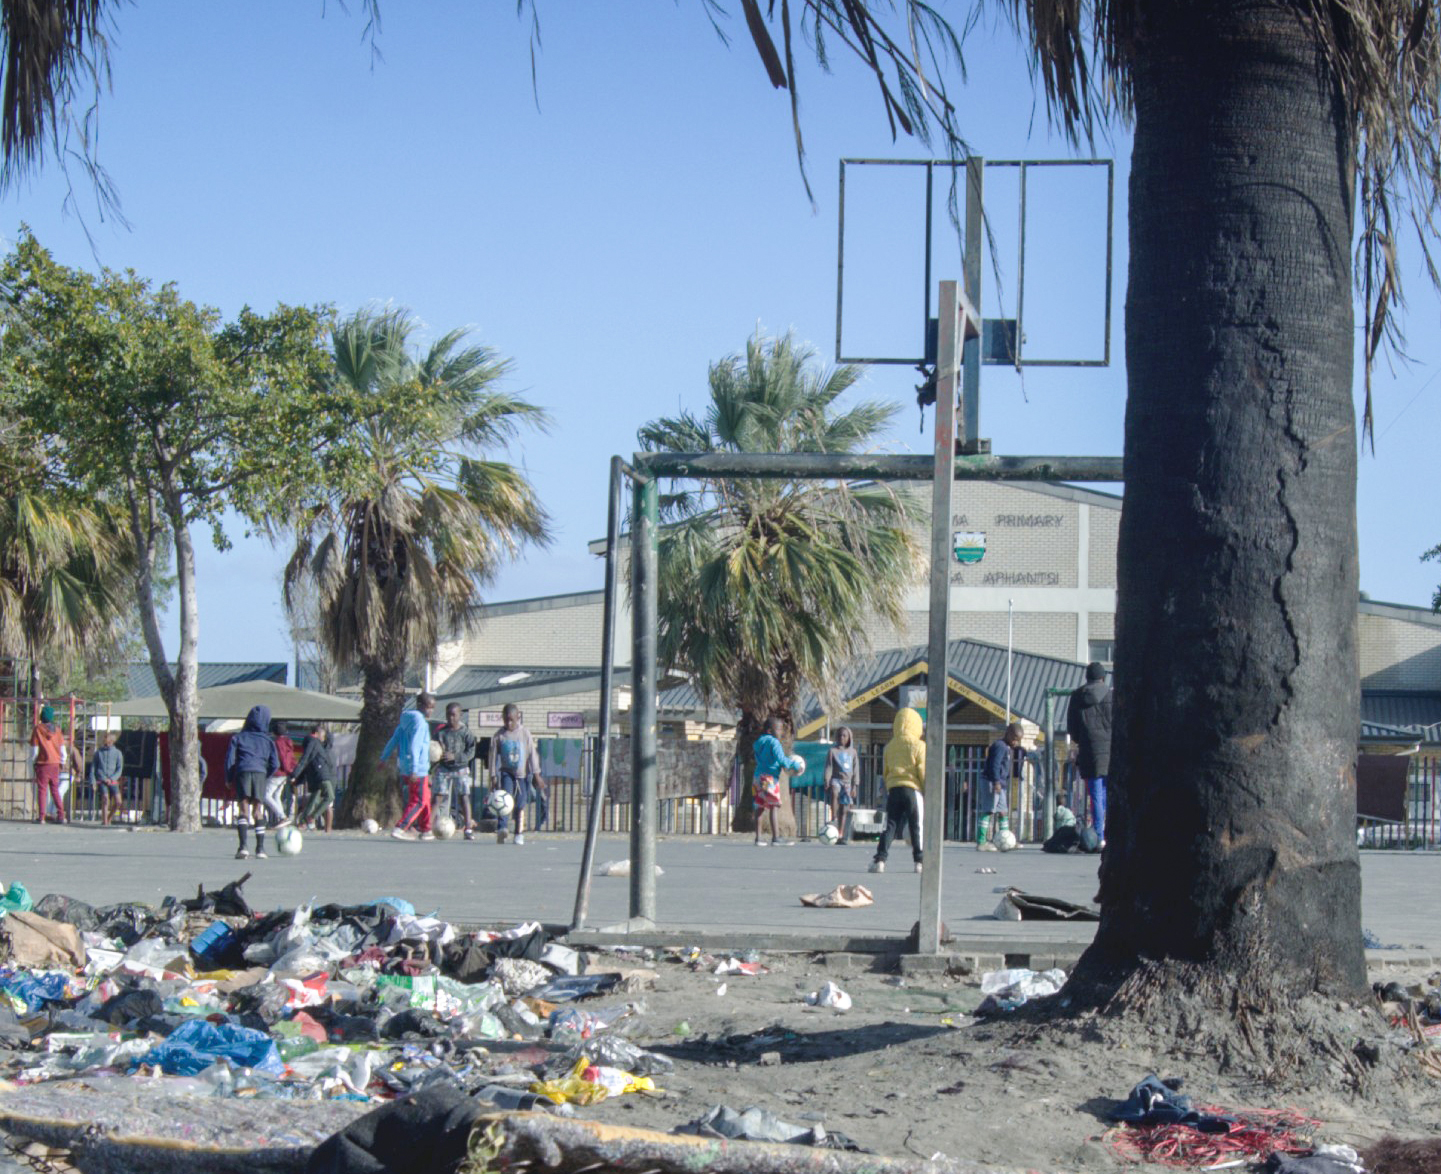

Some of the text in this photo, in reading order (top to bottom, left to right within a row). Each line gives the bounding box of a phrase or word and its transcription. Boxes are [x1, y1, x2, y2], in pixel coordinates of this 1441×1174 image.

[994, 514, 1065, 528] PRIMARY
[855, 679, 896, 706] TO LEARN
[948, 679, 973, 698] LEAVE
[977, 694, 988, 707] TO
